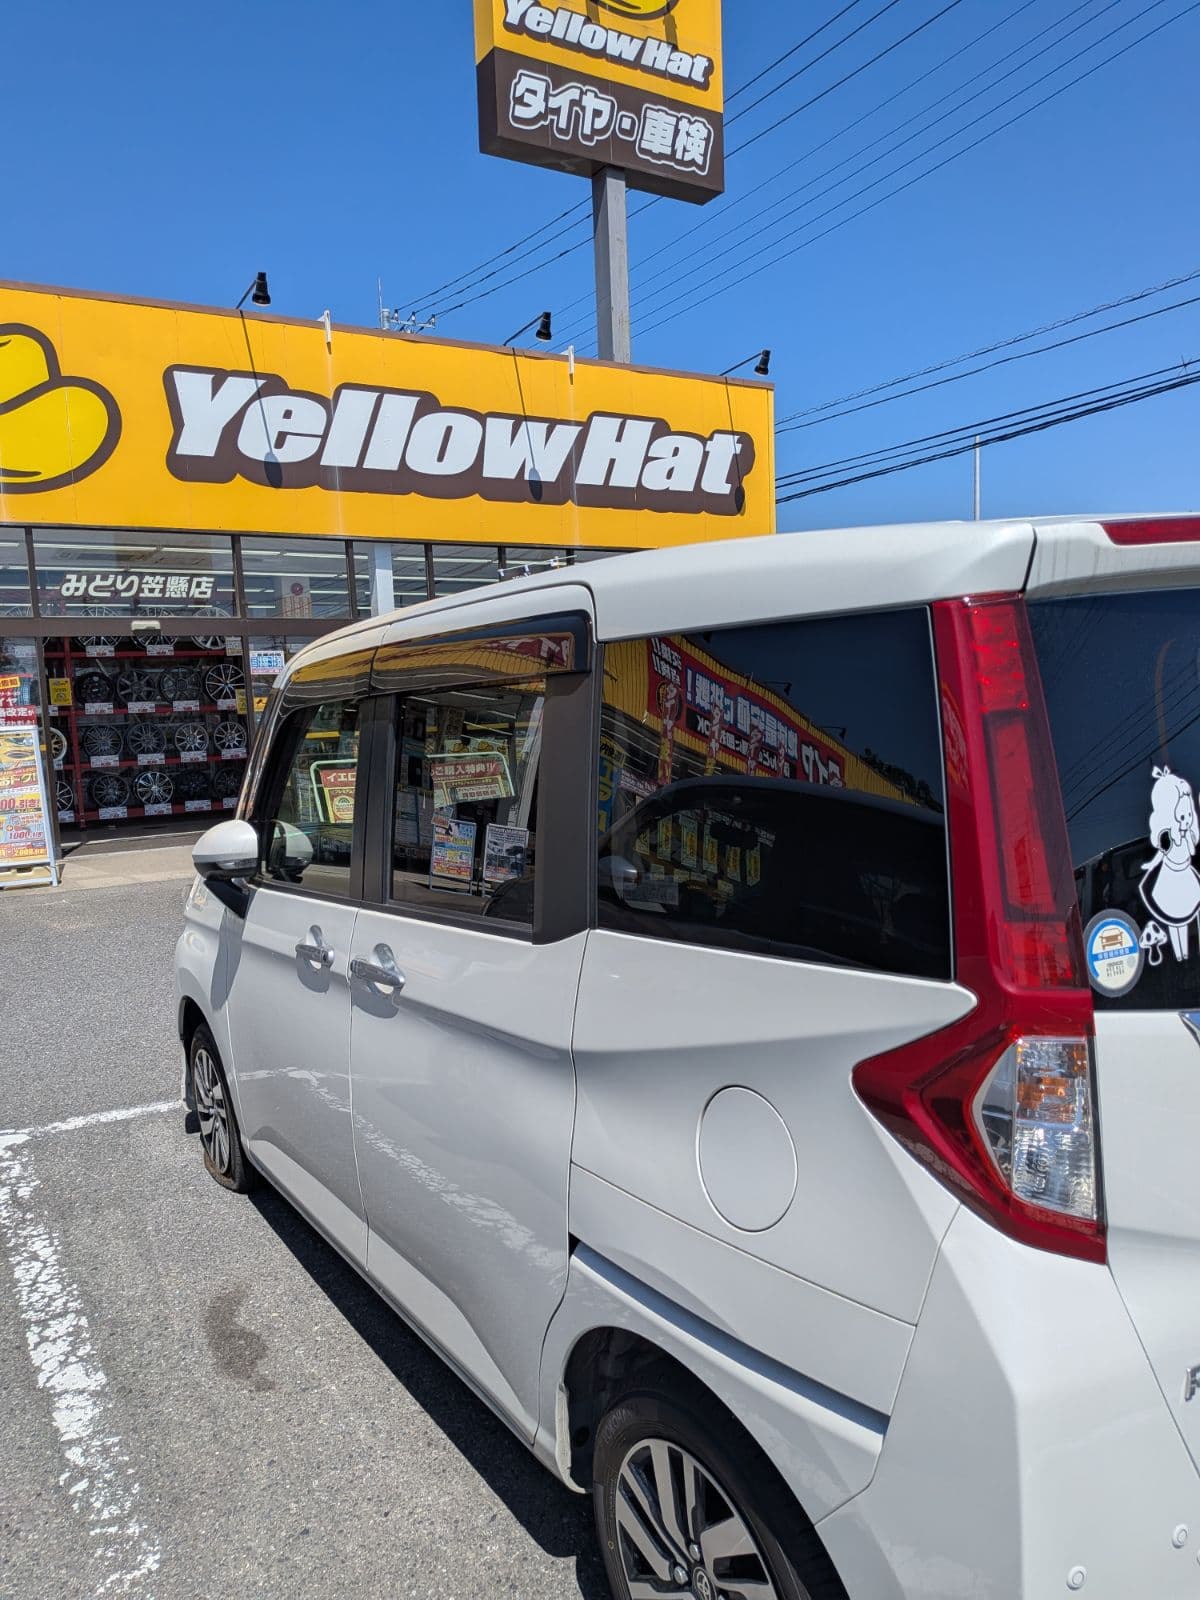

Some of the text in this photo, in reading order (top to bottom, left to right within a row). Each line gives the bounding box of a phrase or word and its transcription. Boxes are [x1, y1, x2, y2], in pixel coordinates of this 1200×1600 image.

[512, 73, 711, 170] タイヤ・車検
[60, 574, 216, 599] みどり笠懸店
